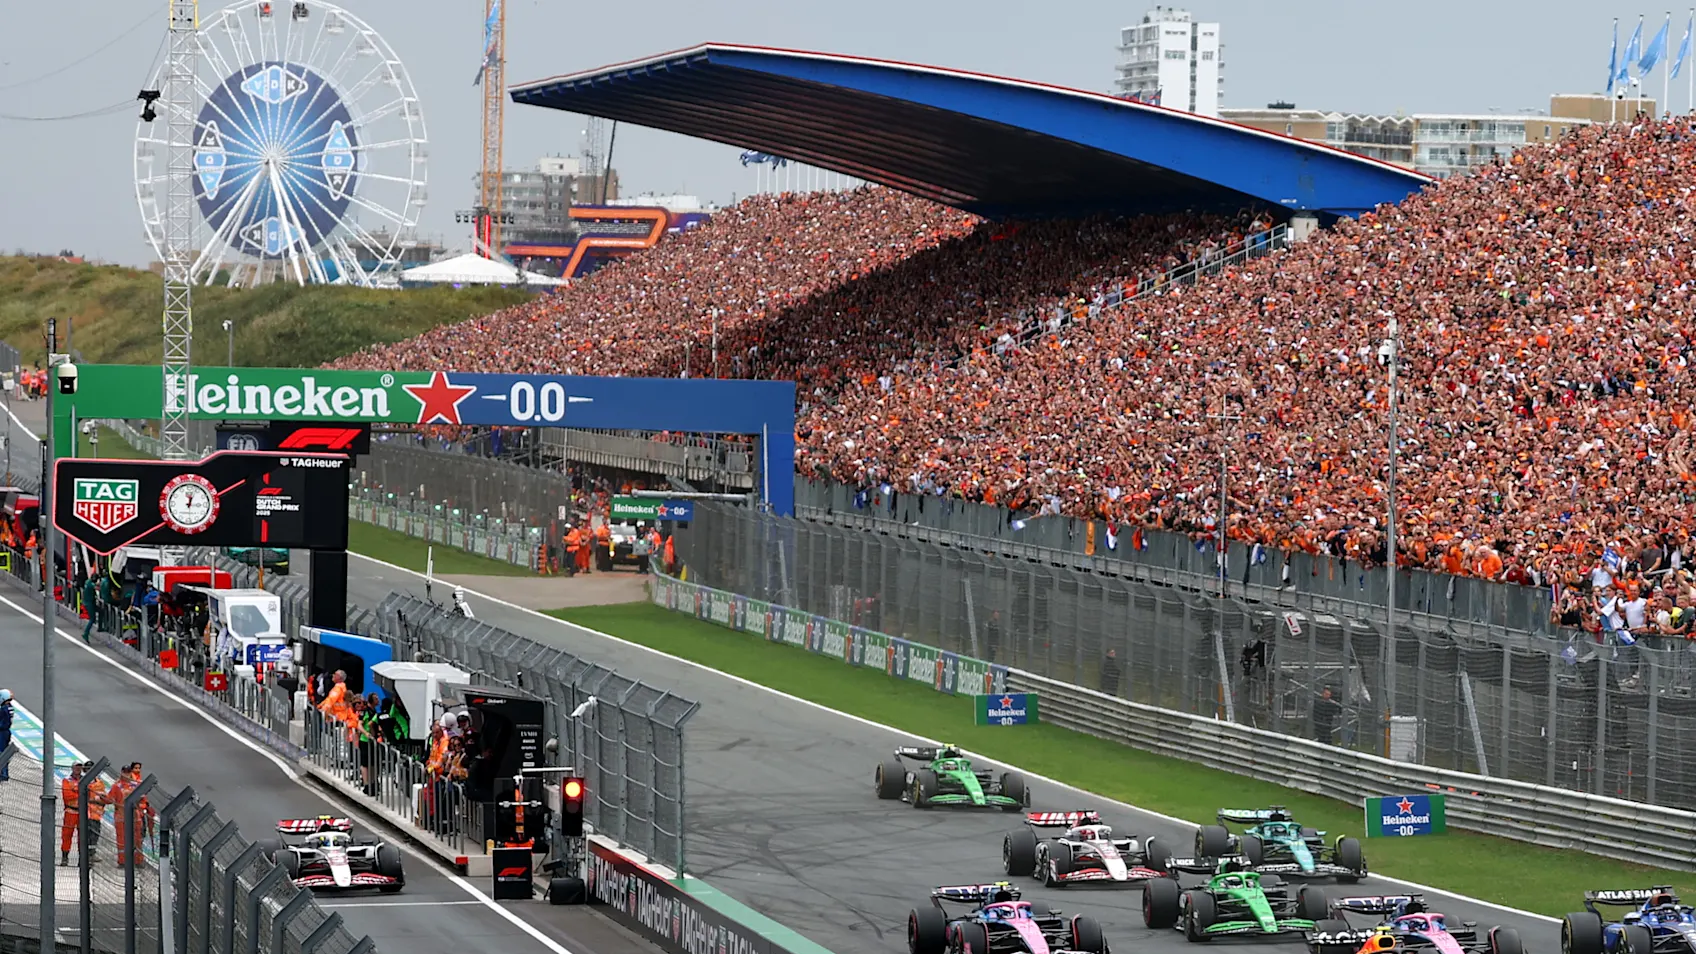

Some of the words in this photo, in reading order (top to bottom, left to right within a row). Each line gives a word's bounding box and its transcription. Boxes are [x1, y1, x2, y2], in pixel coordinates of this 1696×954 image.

[165, 373, 391, 418] Heineken
[510, 381, 566, 422] 0.0
[79, 482, 133, 499] TAG
[77, 502, 136, 526] HEUER
[614, 503, 654, 514] Heineken
[988, 708, 1026, 717] Heineken
[1383, 814, 1429, 825] Heineken
[1400, 825, 1414, 836] 0.0
[1597, 889, 1661, 900] ATLASSIAN
